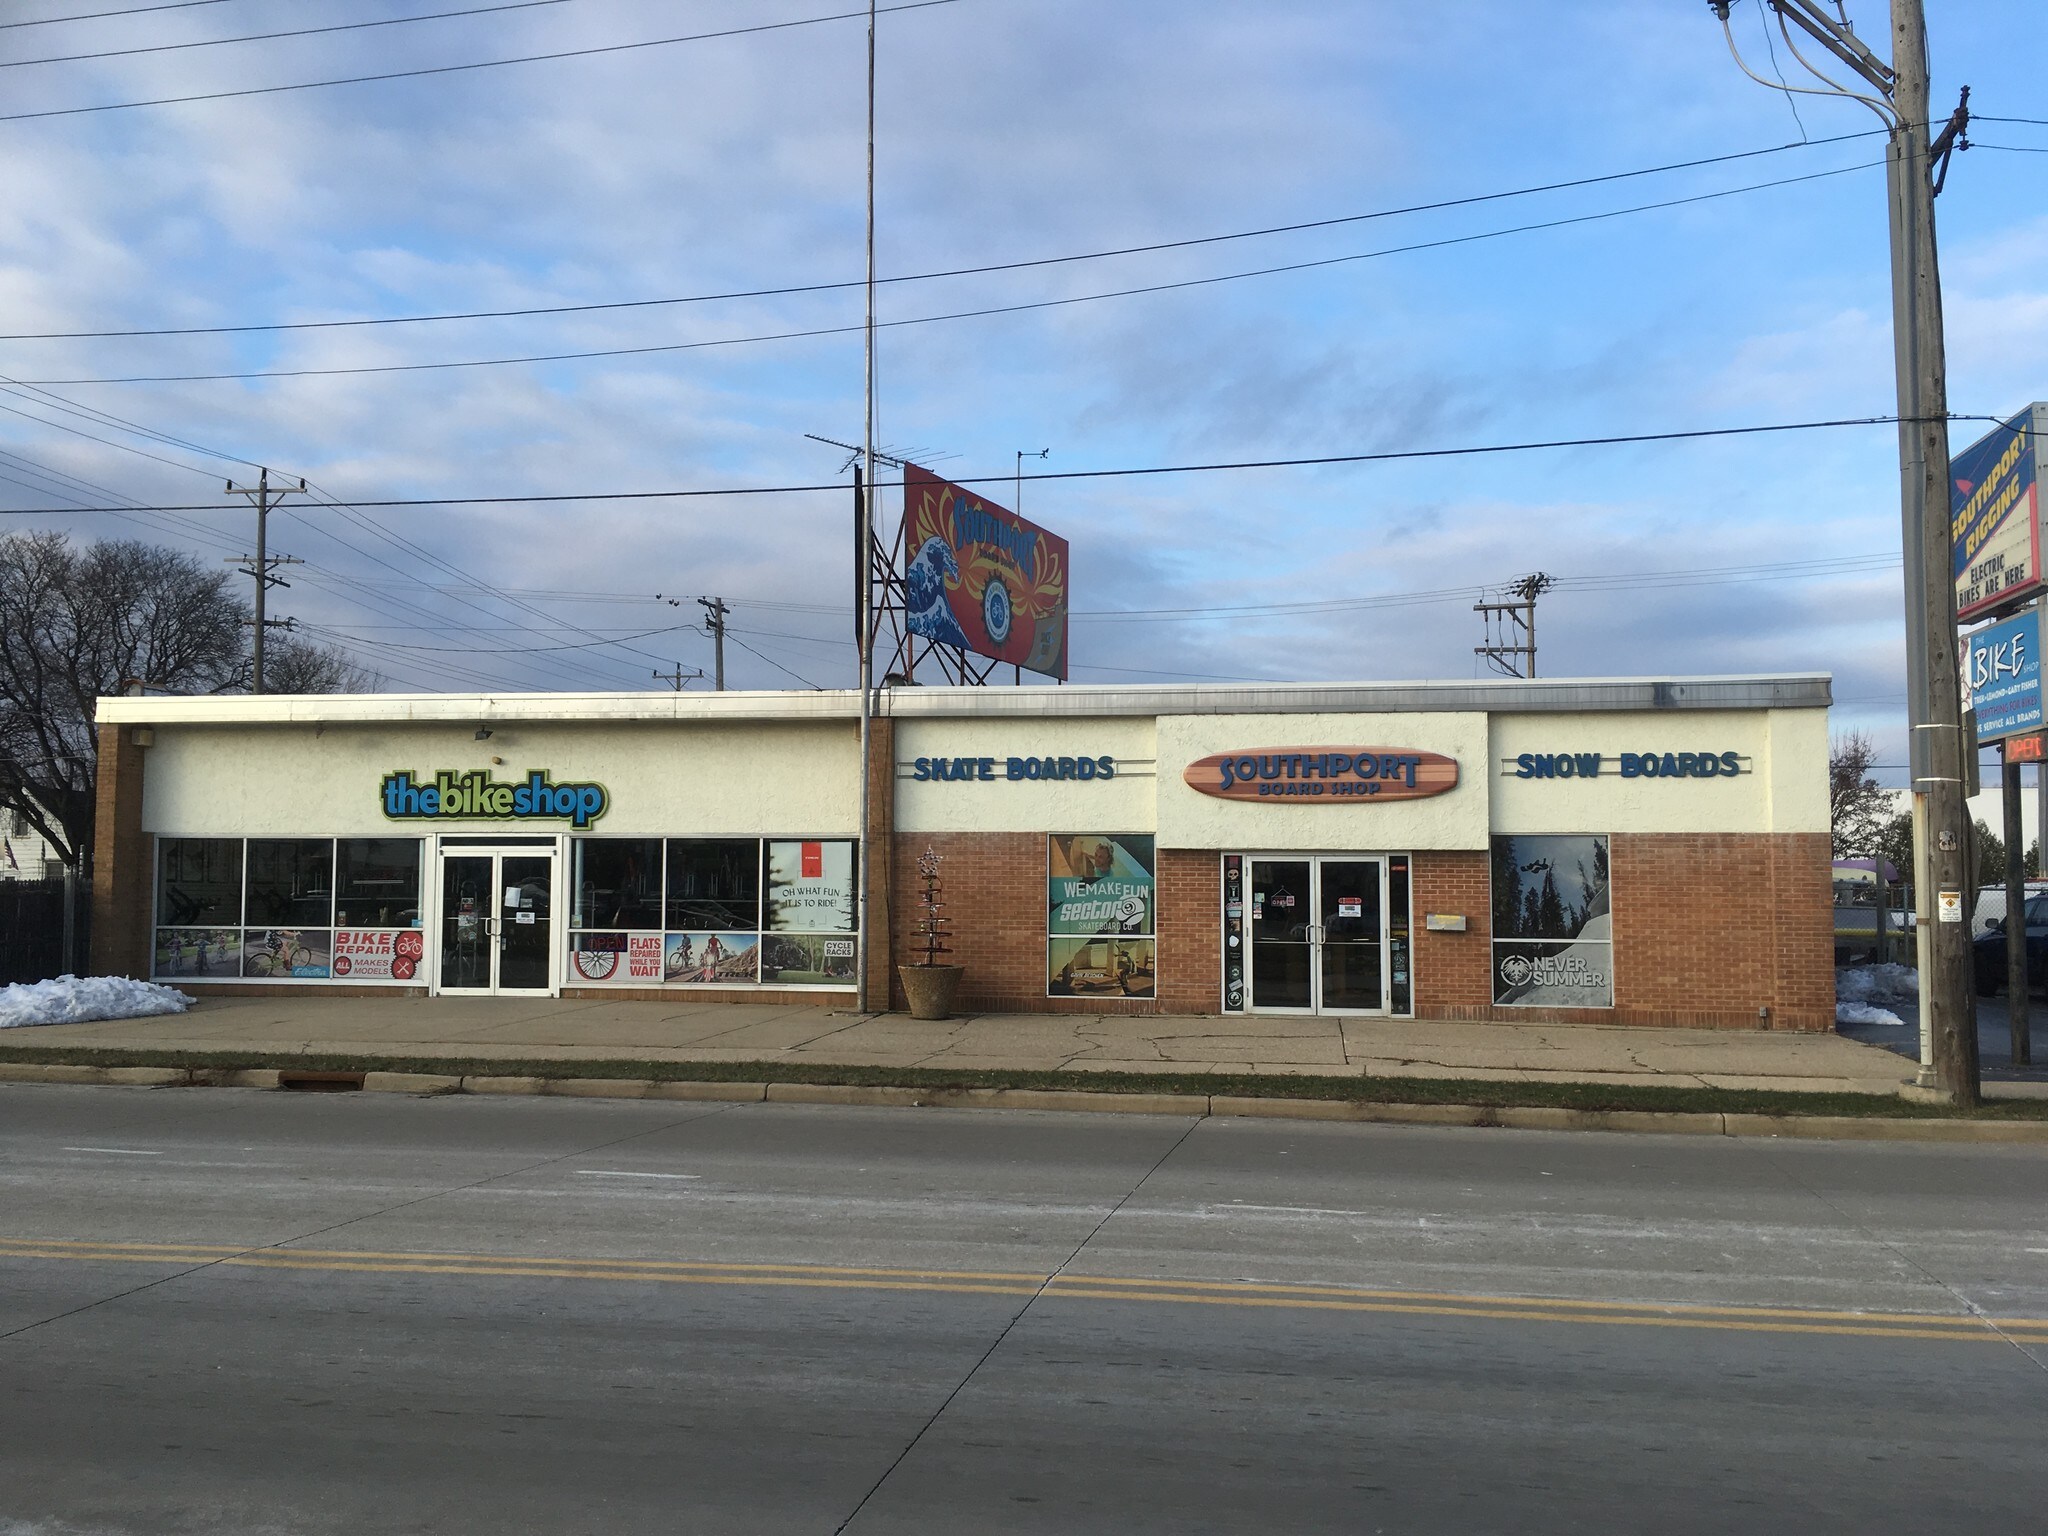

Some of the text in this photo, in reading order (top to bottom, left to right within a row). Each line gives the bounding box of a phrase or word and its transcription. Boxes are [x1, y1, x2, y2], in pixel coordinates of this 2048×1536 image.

[1966, 473, 2019, 560] RIGGING
[1971, 554, 2005, 585] ELECTRIC
[1959, 563, 2025, 608] BIKES ARE HERE
[1975, 635, 1985, 646] THE
[1972, 632, 2025, 690] BIKE
[2023, 661, 2039, 674] SHOP
[2021, 679, 2038, 691] FISHER
[1984, 718, 2004, 731] SERVICE
[2005, 715, 2016, 726] ALL
[2017, 709, 2040, 723] BRANDS
[913, 756, 1114, 781] SKATE BOARDS
[1516, 752, 1740, 778] SNOW BOARDS
[1219, 753, 1420, 791] SOUTHPORT
[1258, 782, 1381, 796] BOARD SHOP
[782, 887, 840, 897] OH WHAT FUN
[785, 899, 837, 907] IT IS TO RIDE!
[1078, 922, 1121, 931] SKATEBOARD
[335, 932, 391, 945] BIKE
[630, 938, 661, 949] FLATS
[335, 945, 391, 954] REPAIR
[629, 950, 661, 958] REPAIRED
[336, 961, 350, 970] ALL
[354, 959, 389, 967] MAKES
[1533, 957, 1588, 972] NEVER
[629, 966, 661, 977] WAIT
[1533, 972, 1605, 987] SUMMER
